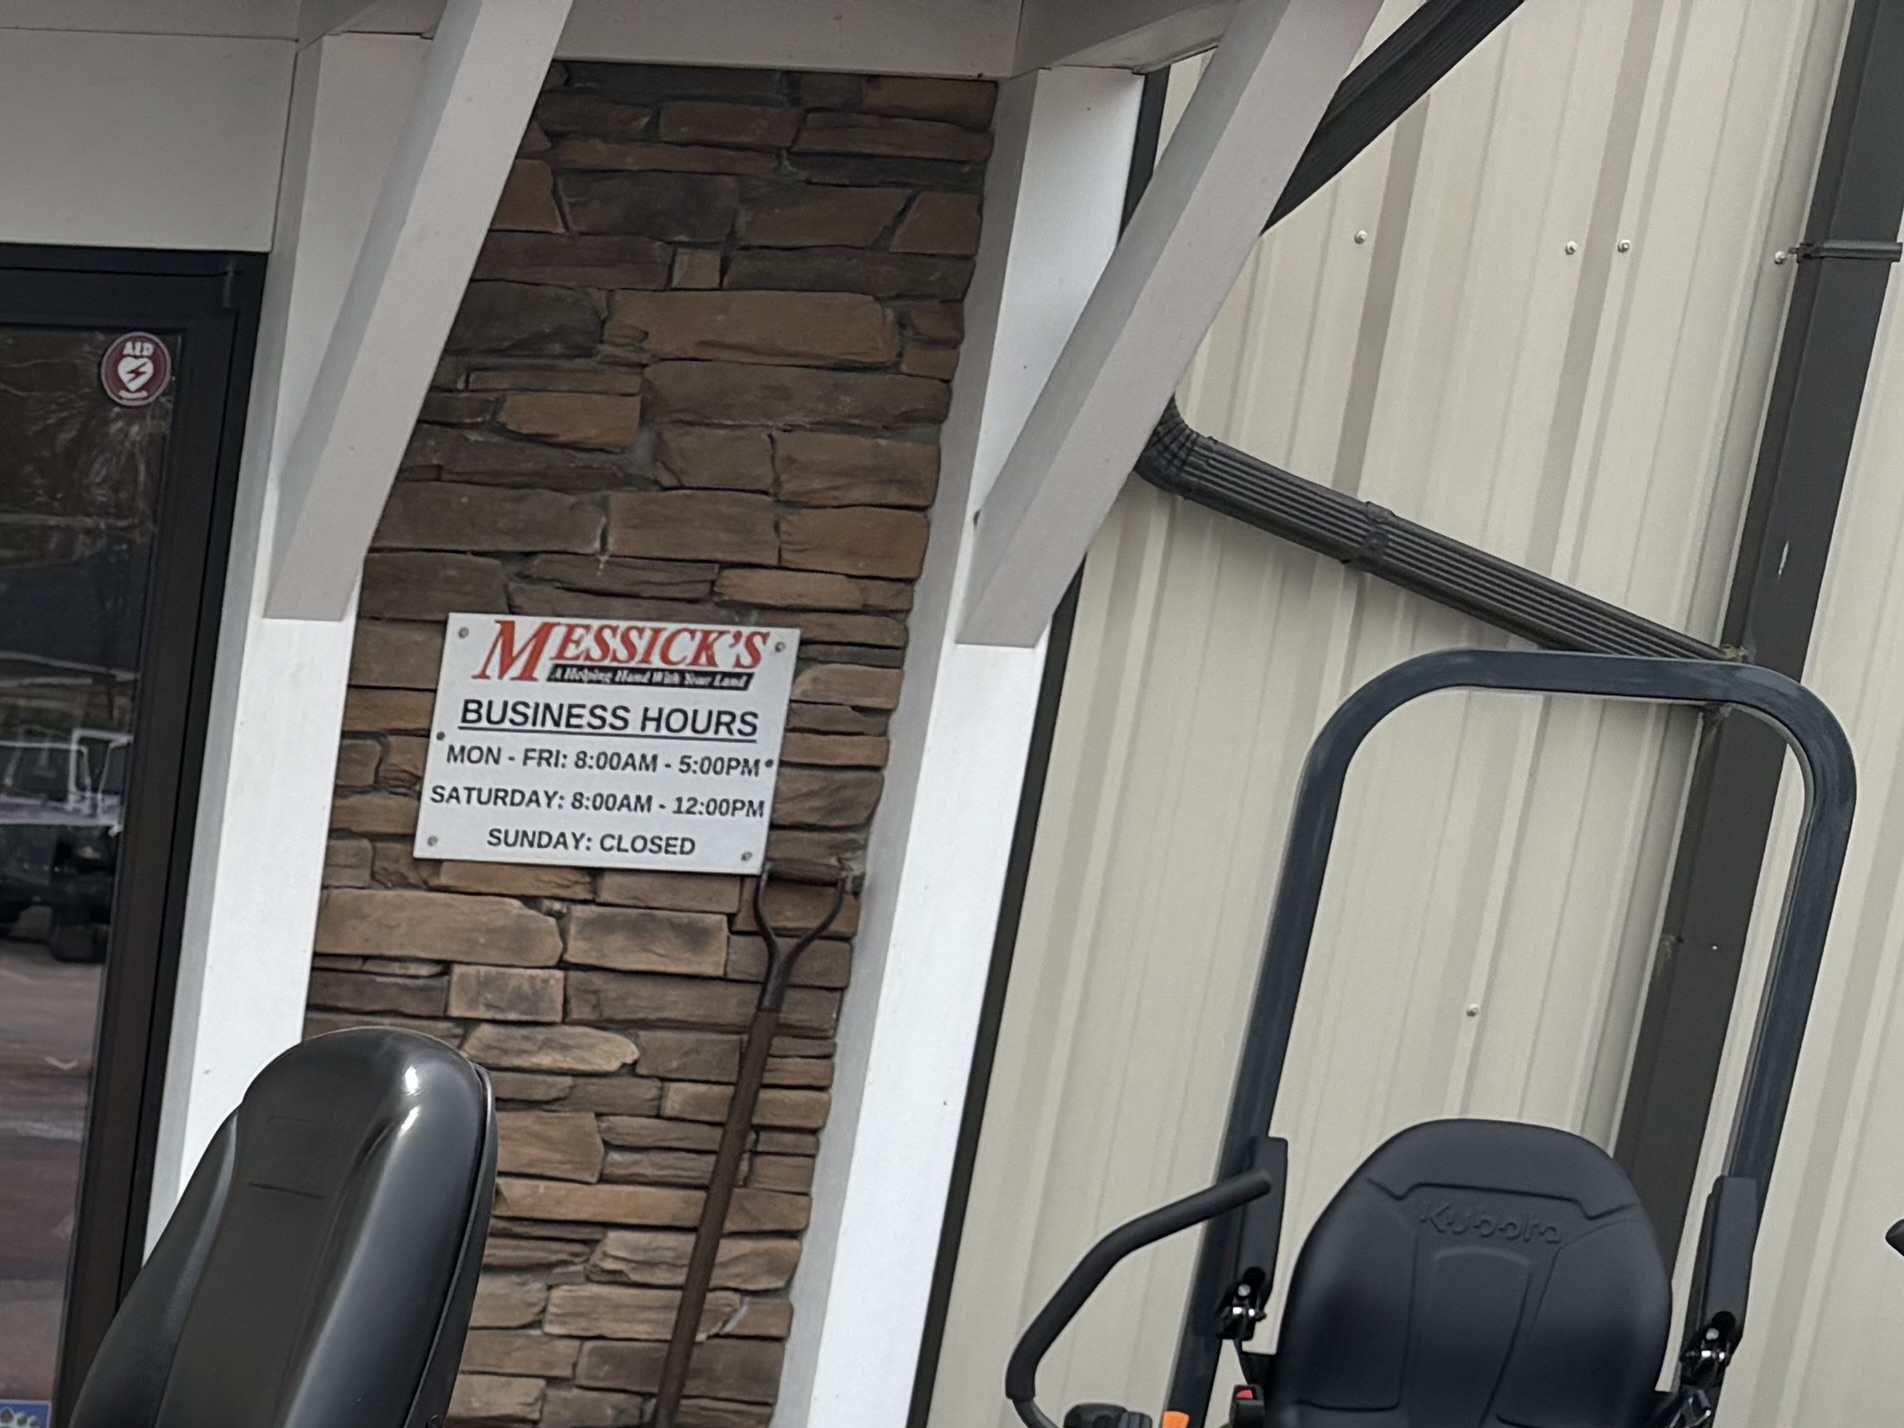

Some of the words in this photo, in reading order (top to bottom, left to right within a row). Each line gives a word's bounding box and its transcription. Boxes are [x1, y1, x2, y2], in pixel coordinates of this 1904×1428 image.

[472, 619, 770, 682] MESSICK'S
[564, 668, 612, 683] Helping
[614, 669, 651, 683] Hand
[652, 671, 680, 685] With
[713, 673, 746, 688] Land
[461, 699, 630, 730] BUSINESS
[641, 706, 759, 737] HOURS
[446, 745, 501, 766] MON
[522, 748, 567, 769] FRI:
[574, 751, 658, 773] 8:00AM
[678, 755, 761, 777] 5:00PM
[430, 785, 565, 810] SATURDAY:
[571, 793, 653, 814] 8:00AM
[672, 797, 764, 819] 12:00PM
[487, 829, 593, 852] SUNDAY:
[599, 834, 696, 856] CLOSED
